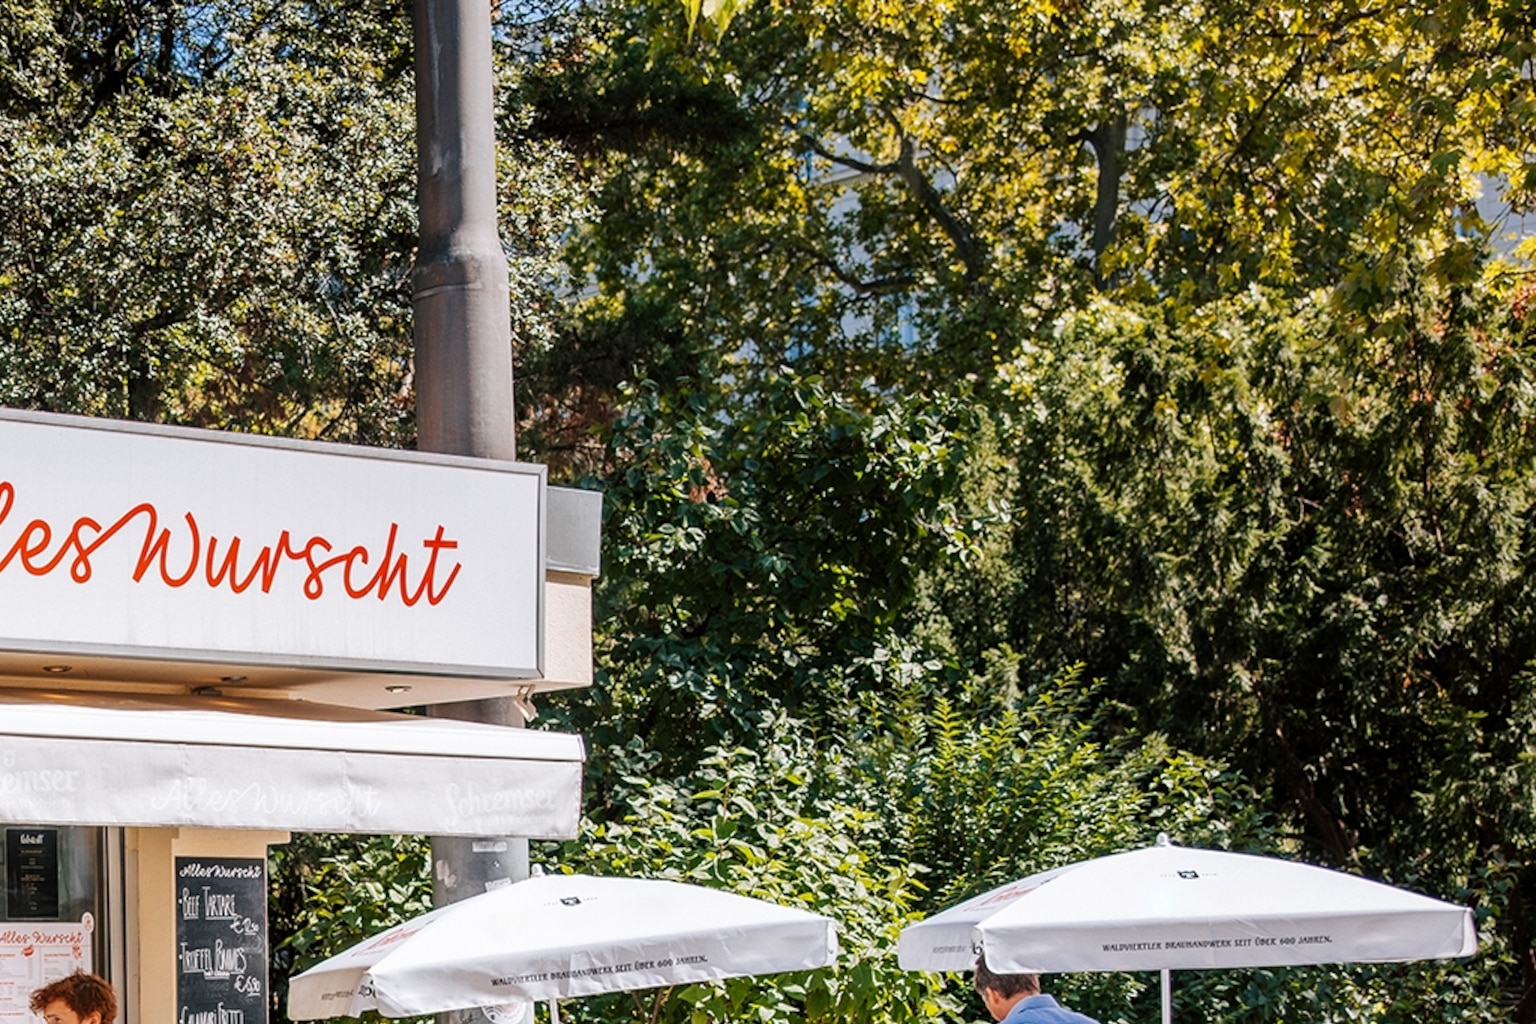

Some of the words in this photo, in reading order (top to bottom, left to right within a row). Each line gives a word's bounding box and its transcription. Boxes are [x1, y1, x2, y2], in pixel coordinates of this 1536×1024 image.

[32, 930, 84, 944] Wurscht
[1102, 942, 1162, 952] WALDVIERTLER
[1165, 939, 1232, 950] BRAUHANDWERK
[1234, 938, 1252, 948] SEIT
[1279, 936, 1296, 946] 600
[615, 963, 633, 975] SEIT
[656, 958, 674, 969] 600
